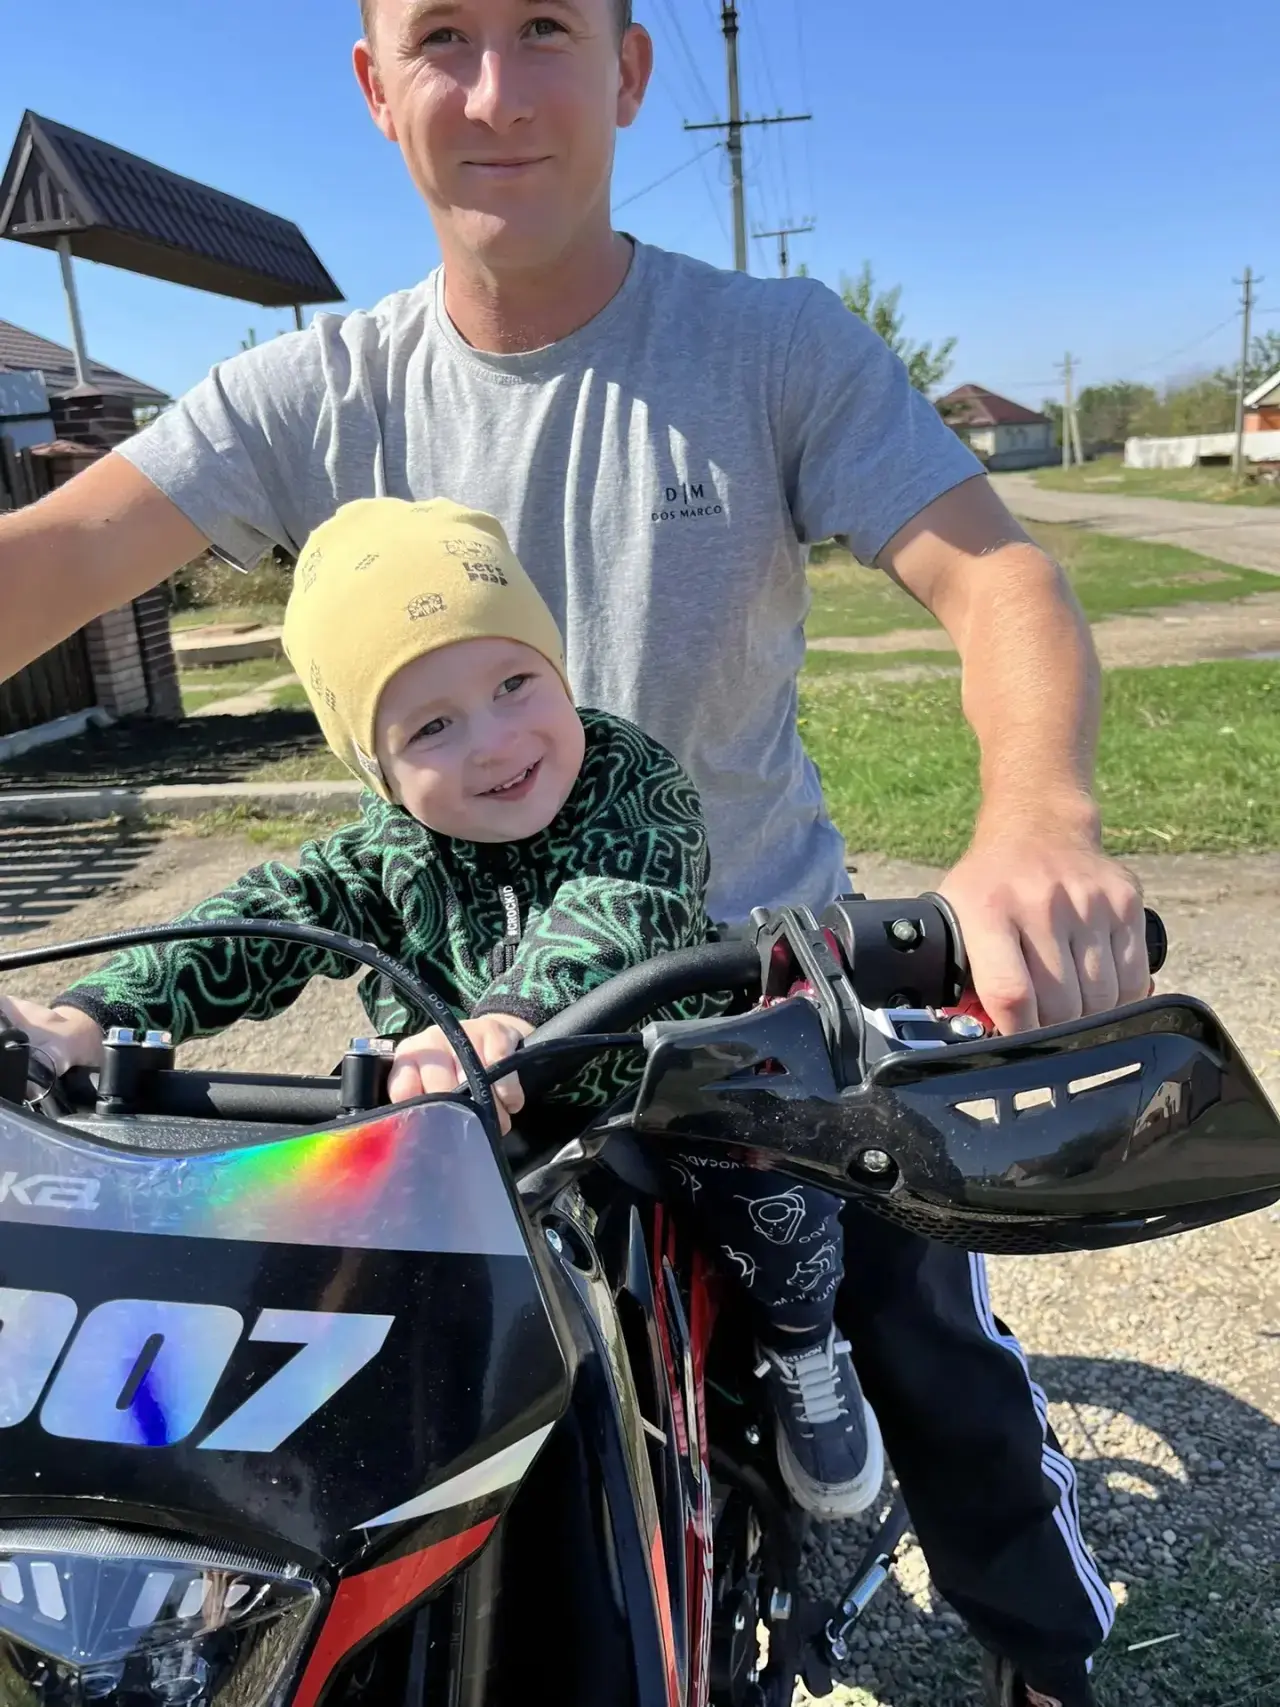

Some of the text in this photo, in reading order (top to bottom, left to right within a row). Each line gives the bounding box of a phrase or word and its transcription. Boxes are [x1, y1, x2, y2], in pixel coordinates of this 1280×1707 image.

[651, 505, 722, 521] DOS MARCO
[428, 993, 450, 1016] DOT
[454, 1027, 473, 1055] SAE
